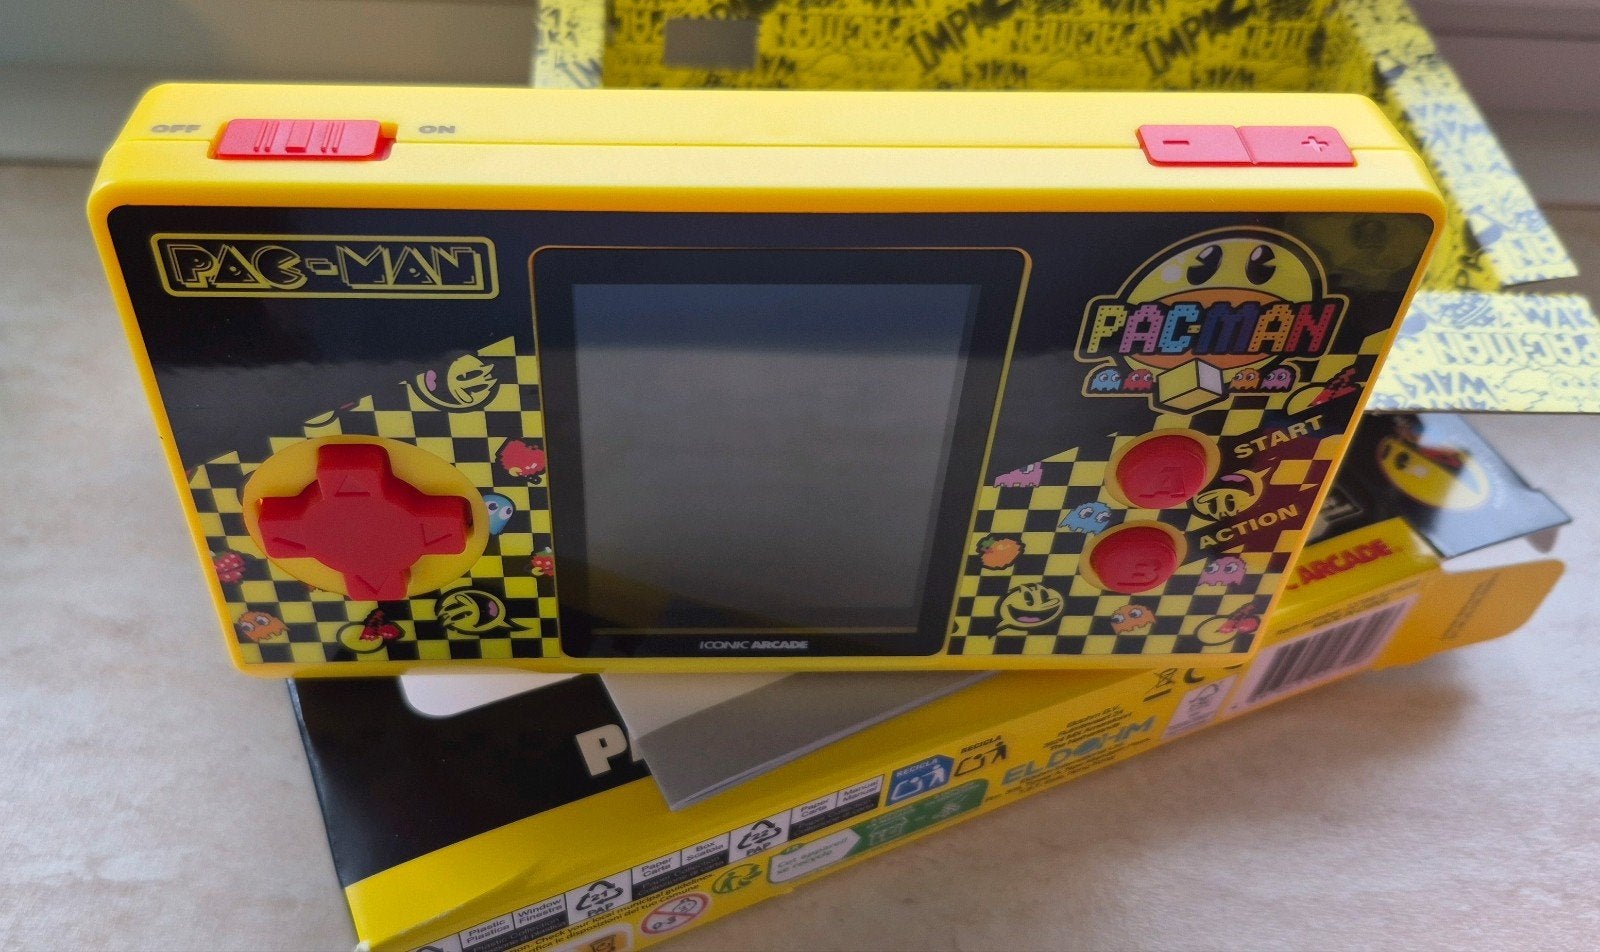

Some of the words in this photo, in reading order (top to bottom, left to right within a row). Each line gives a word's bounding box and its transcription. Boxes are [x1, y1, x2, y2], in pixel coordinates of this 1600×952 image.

[150, 124, 201, 134] OFF
[418, 125, 456, 135] ON
[166, 243, 484, 291] PAC-MAN
[1233, 415, 1323, 459] START
[1199, 504, 1299, 550] ACTION
[1296, 538, 1393, 584] ARCADE
[699, 641, 750, 650] ICONIC
[750, 640, 809, 649] ARCADE
[896, 757, 939, 776] RECICLA
[695, 841, 716, 852] Box
[746, 842, 772, 856] PAP
[641, 857, 673, 871] Paper
[643, 864, 671, 877] Carta
[590, 889, 608, 900] 21
[517, 898, 561, 917] Window
[519, 905, 562, 924] Finestra
[587, 902, 614, 917] PAP
[535, 930, 565, 945] Check
[567, 919, 590, 933] your
[592, 910, 615, 923] local
[616, 889, 664, 915] municipal
[566, 914, 621, 941] disposizioni
[641, 903, 656, 914] tuo
[467, 924, 510, 943] Plastica
[469, 919, 506, 936] Plastic
